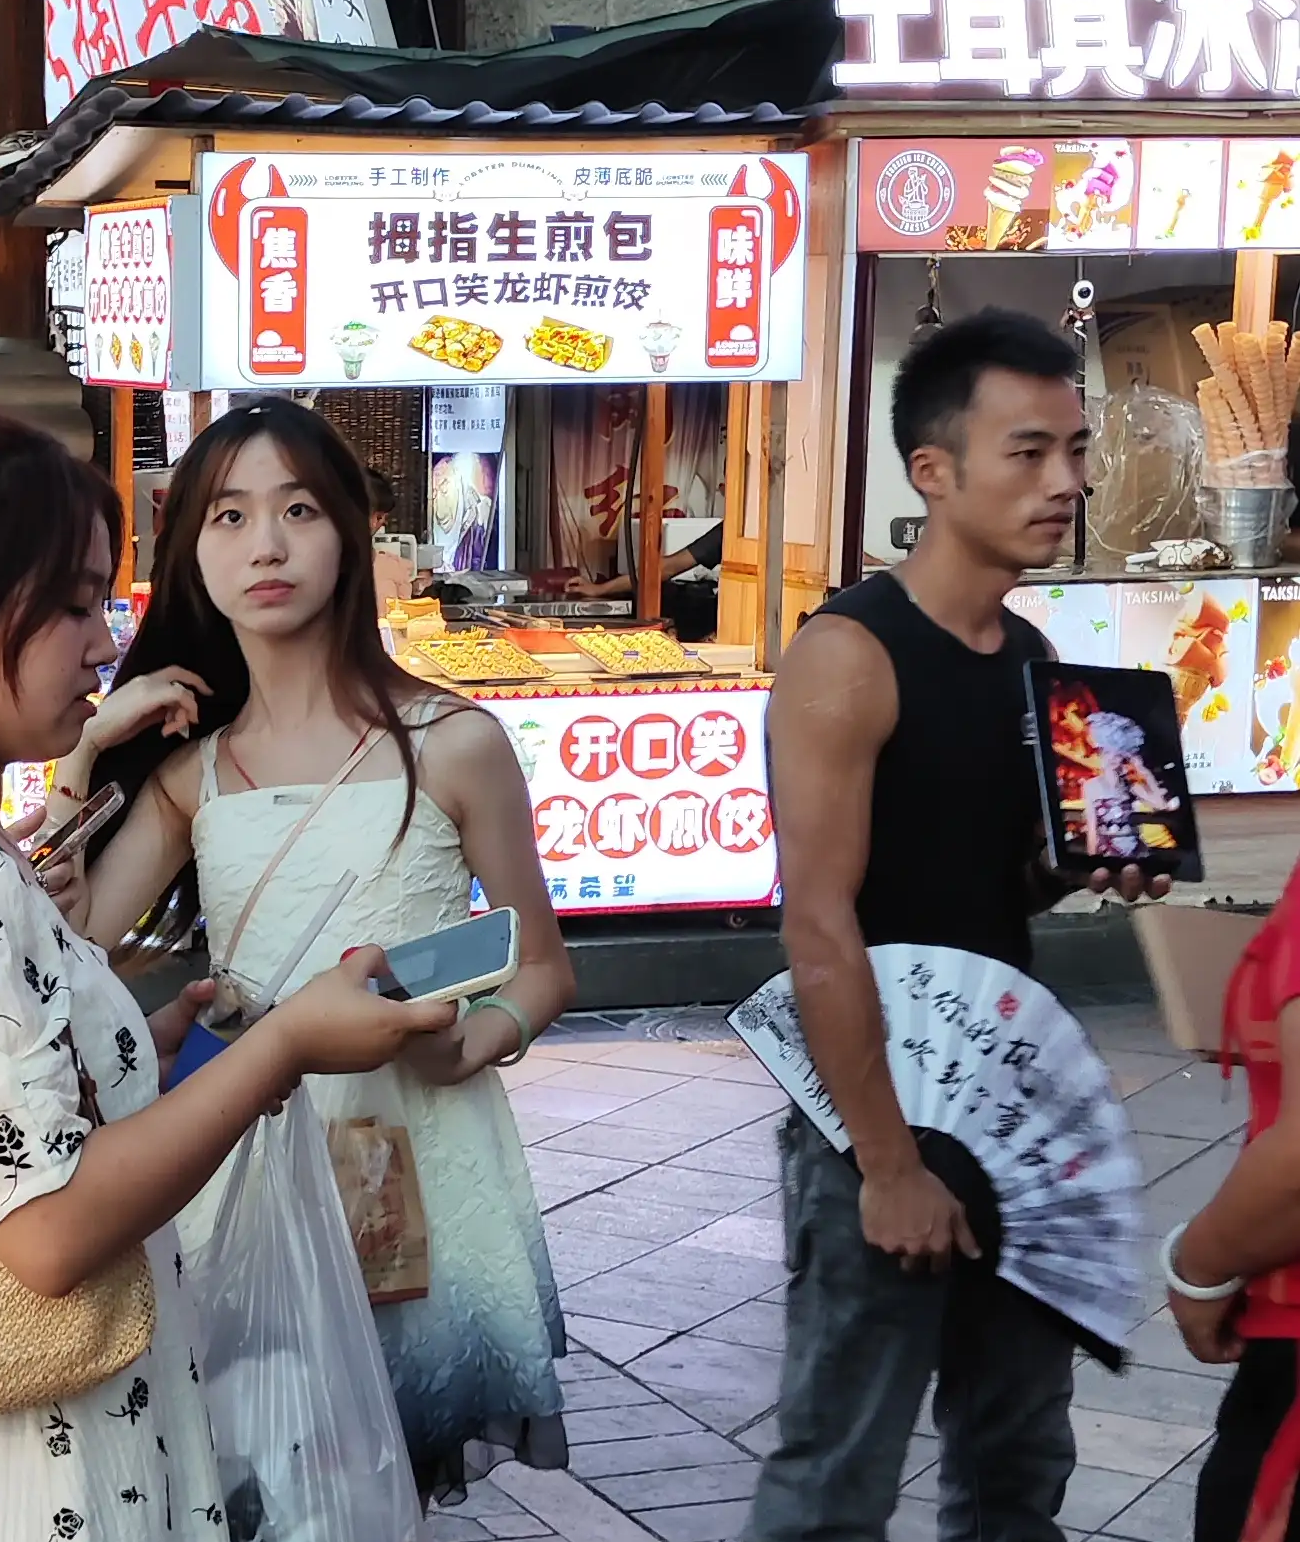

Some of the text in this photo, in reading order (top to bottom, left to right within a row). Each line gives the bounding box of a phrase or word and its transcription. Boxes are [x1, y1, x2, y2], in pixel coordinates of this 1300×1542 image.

[369, 166, 450, 186] 手工制作
[572, 167, 653, 187] 皮薄底脆
[368, 211, 653, 265] 拇指生煎包
[259, 227, 300, 313] 焦香
[715, 224, 755, 308] 味鲜
[370, 270, 652, 315] 开口笑龙虾煎饺
[1005, 593, 1044, 609] KSIM
[1124, 590, 1177, 605] TAKSIM
[1261, 585, 1300, 601] TAKSI
[569, 715, 739, 776] 开口笑
[537, 792, 767, 855] 龙虾煎饺
